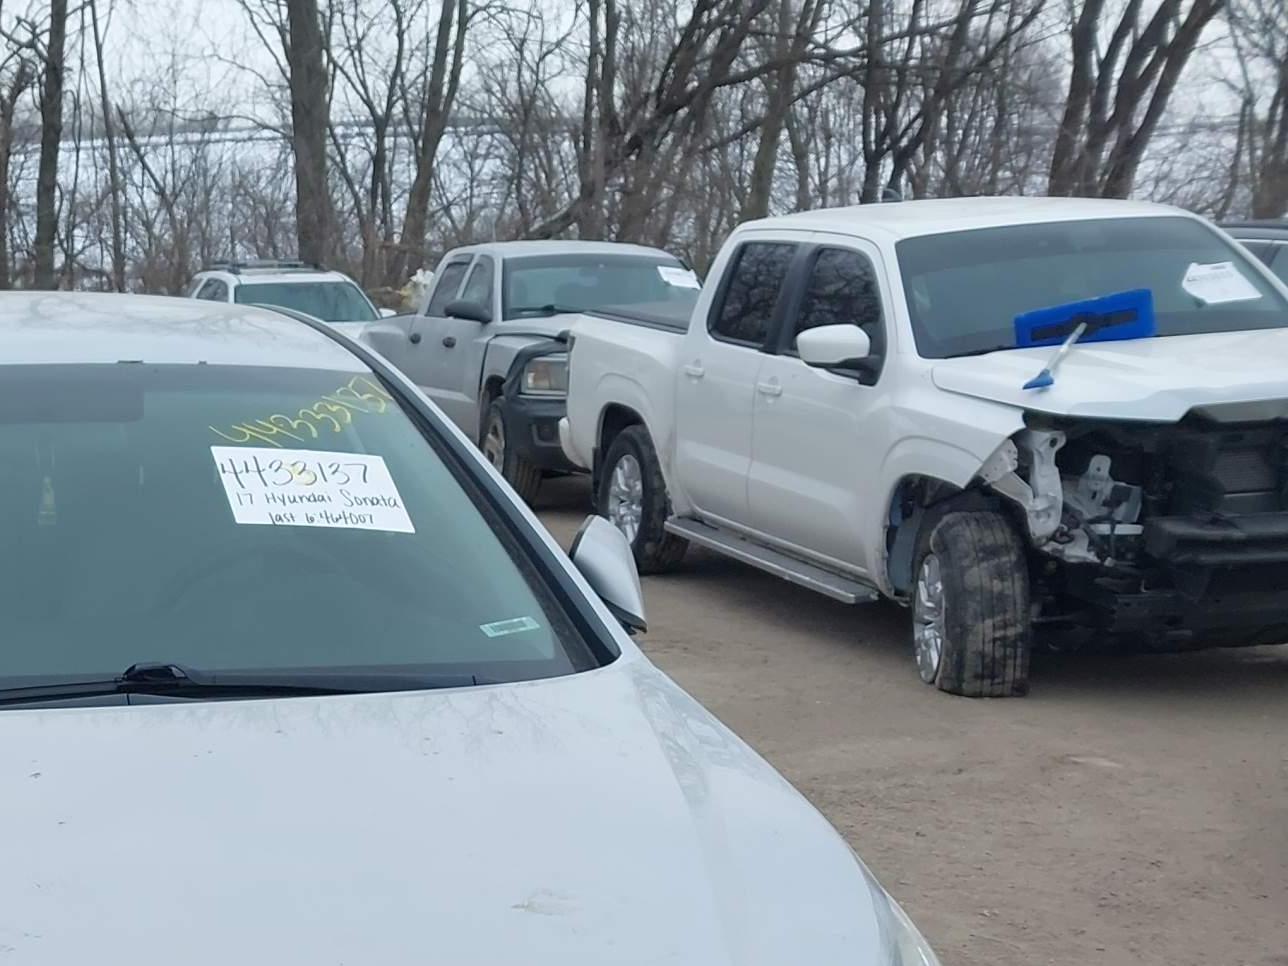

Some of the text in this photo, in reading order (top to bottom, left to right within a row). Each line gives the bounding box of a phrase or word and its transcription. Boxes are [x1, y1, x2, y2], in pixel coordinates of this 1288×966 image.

[236, 489, 401, 508] 17 Hyundai Sonata
[269, 511, 296, 525] last
